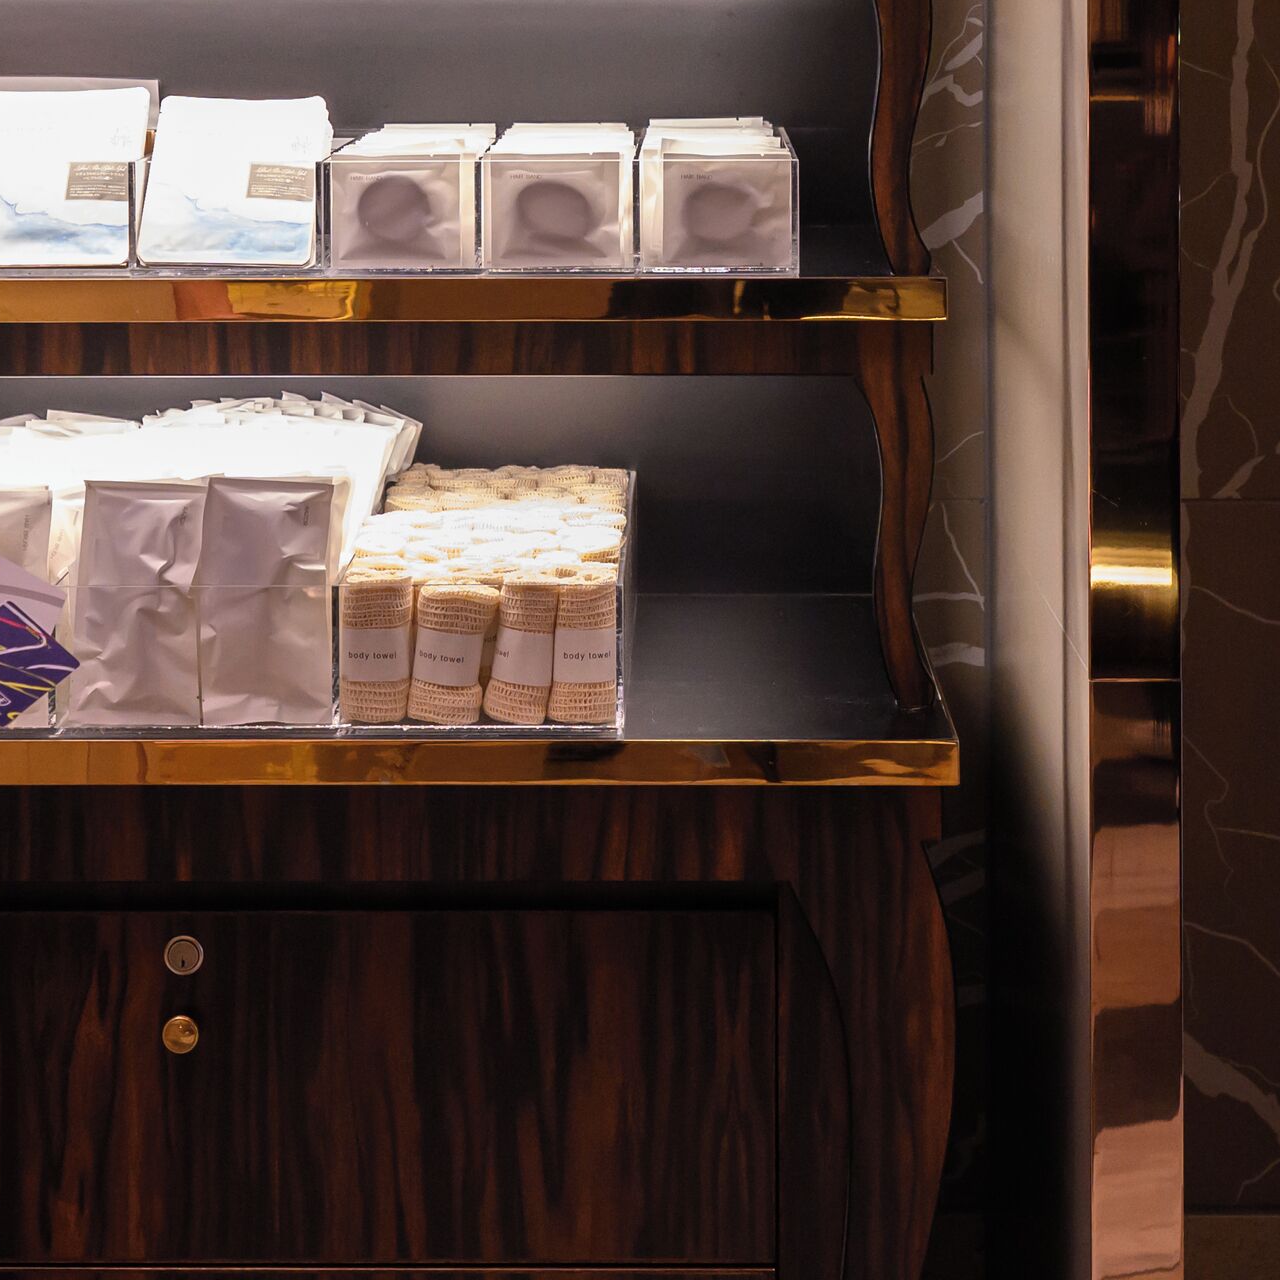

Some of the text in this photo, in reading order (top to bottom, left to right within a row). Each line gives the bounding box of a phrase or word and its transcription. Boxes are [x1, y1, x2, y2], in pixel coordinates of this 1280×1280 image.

[348, 651, 397, 661] body towel
[419, 650, 465, 664] body towel
[563, 650, 611, 661] body towel
